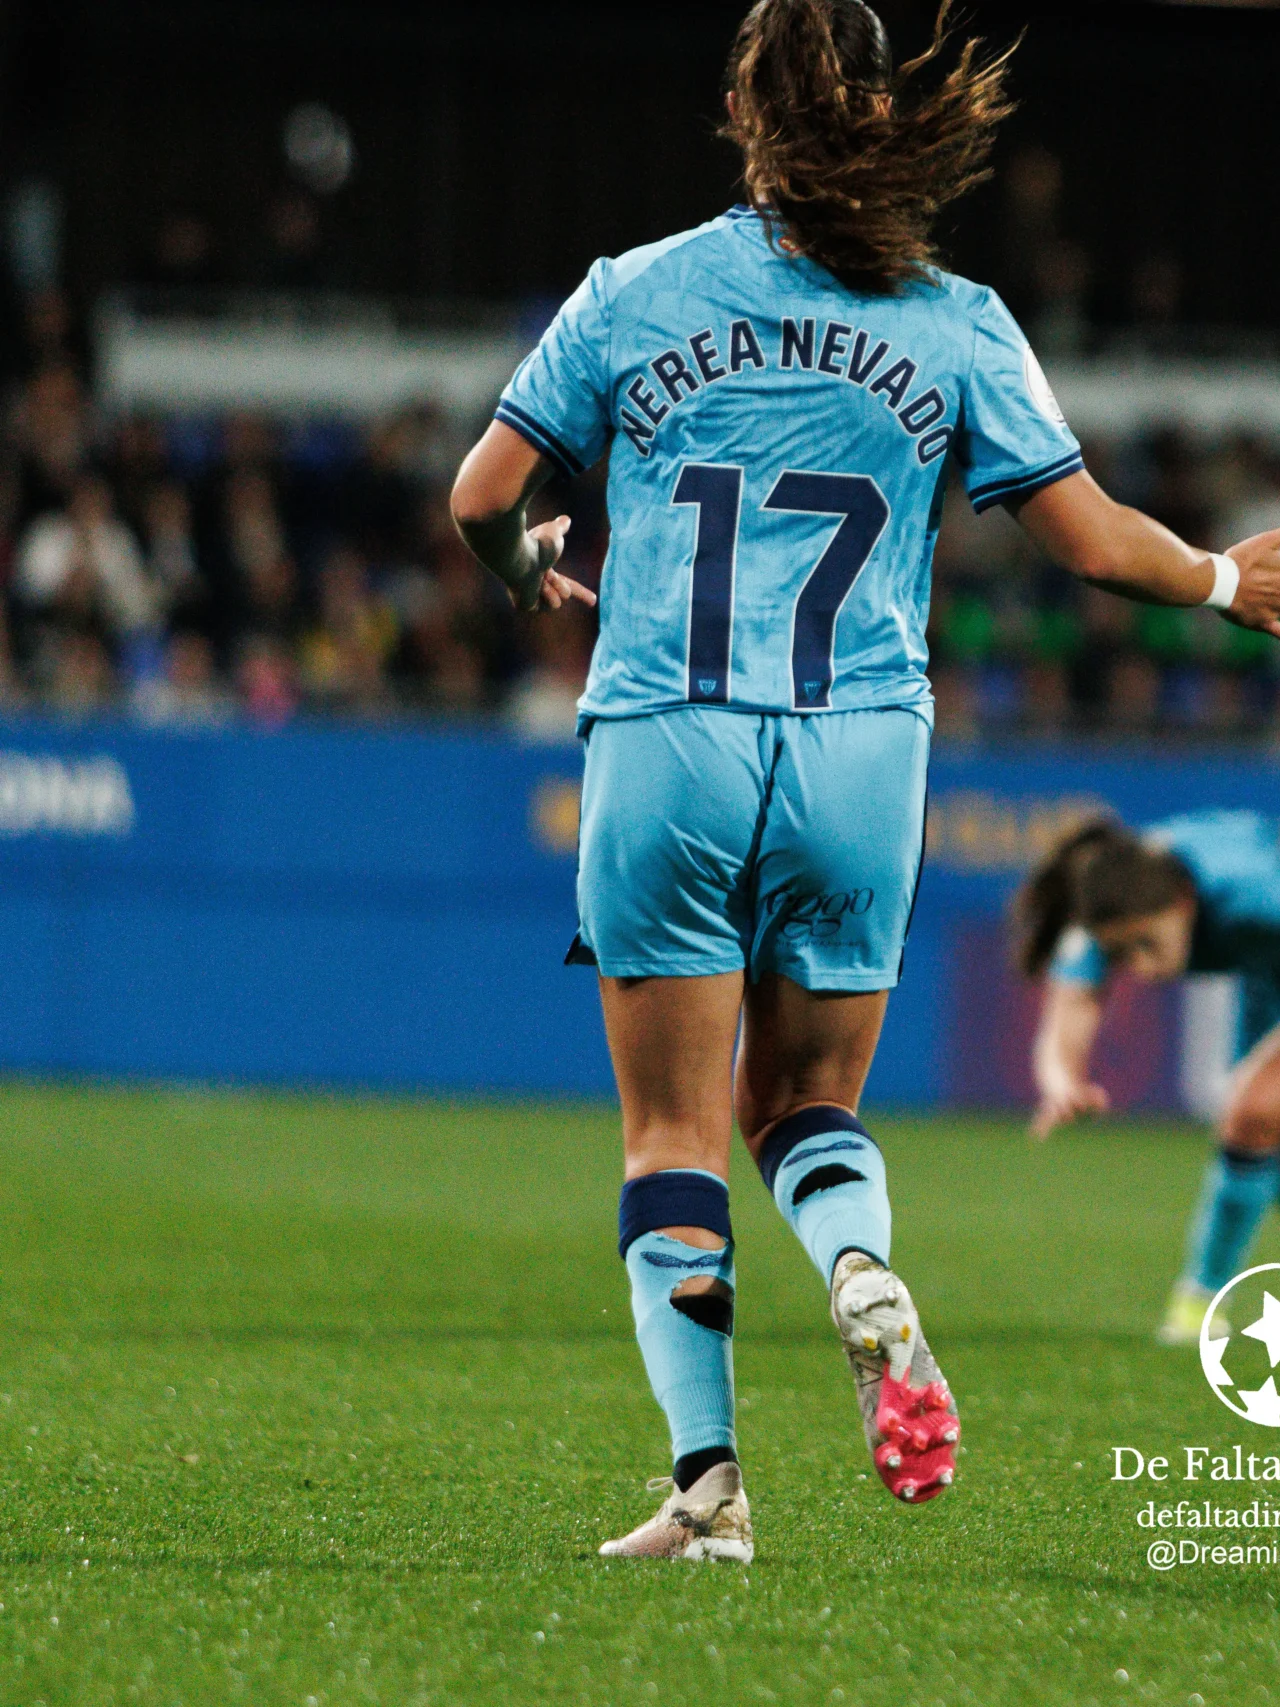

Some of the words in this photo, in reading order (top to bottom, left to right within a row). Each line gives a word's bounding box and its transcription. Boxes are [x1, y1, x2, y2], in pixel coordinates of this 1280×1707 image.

[618, 317, 766, 458] NEREA
[780, 316, 954, 466] NEVADO
[670, 462, 892, 711] 17
